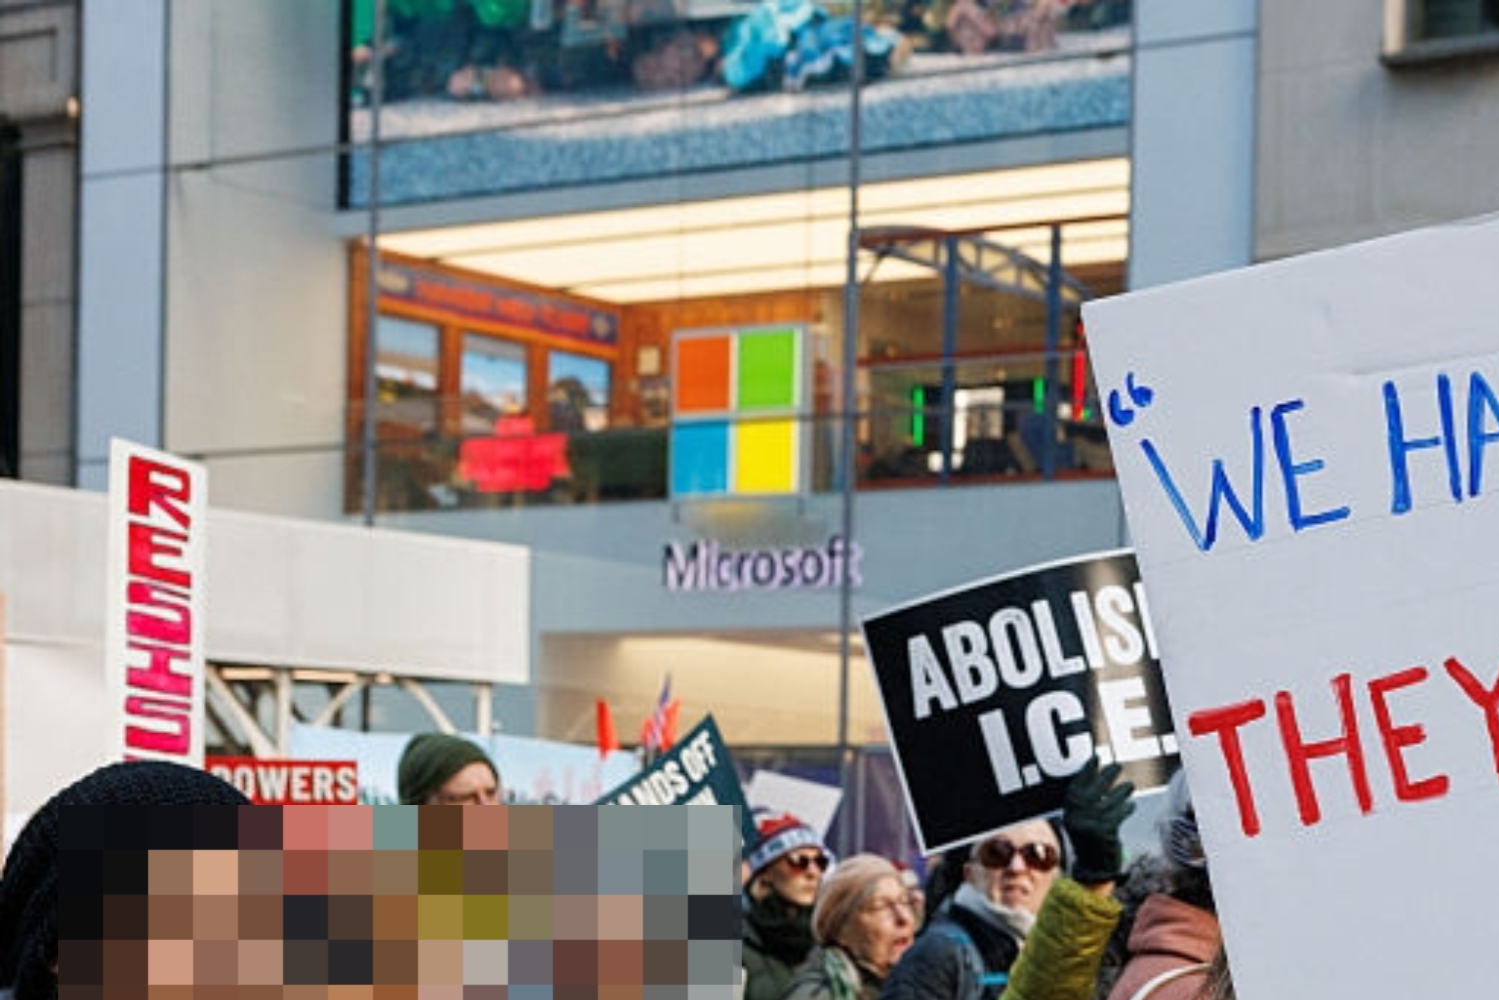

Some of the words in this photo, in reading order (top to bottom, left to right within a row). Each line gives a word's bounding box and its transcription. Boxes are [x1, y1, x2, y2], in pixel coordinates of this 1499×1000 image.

[123, 454, 192, 761] RESIS
[662, 537, 864, 592] Microsoft
[607, 761, 689, 805] NDS
[680, 730, 717, 782] OFF
[977, 676, 1179, 795] I.C.E.
